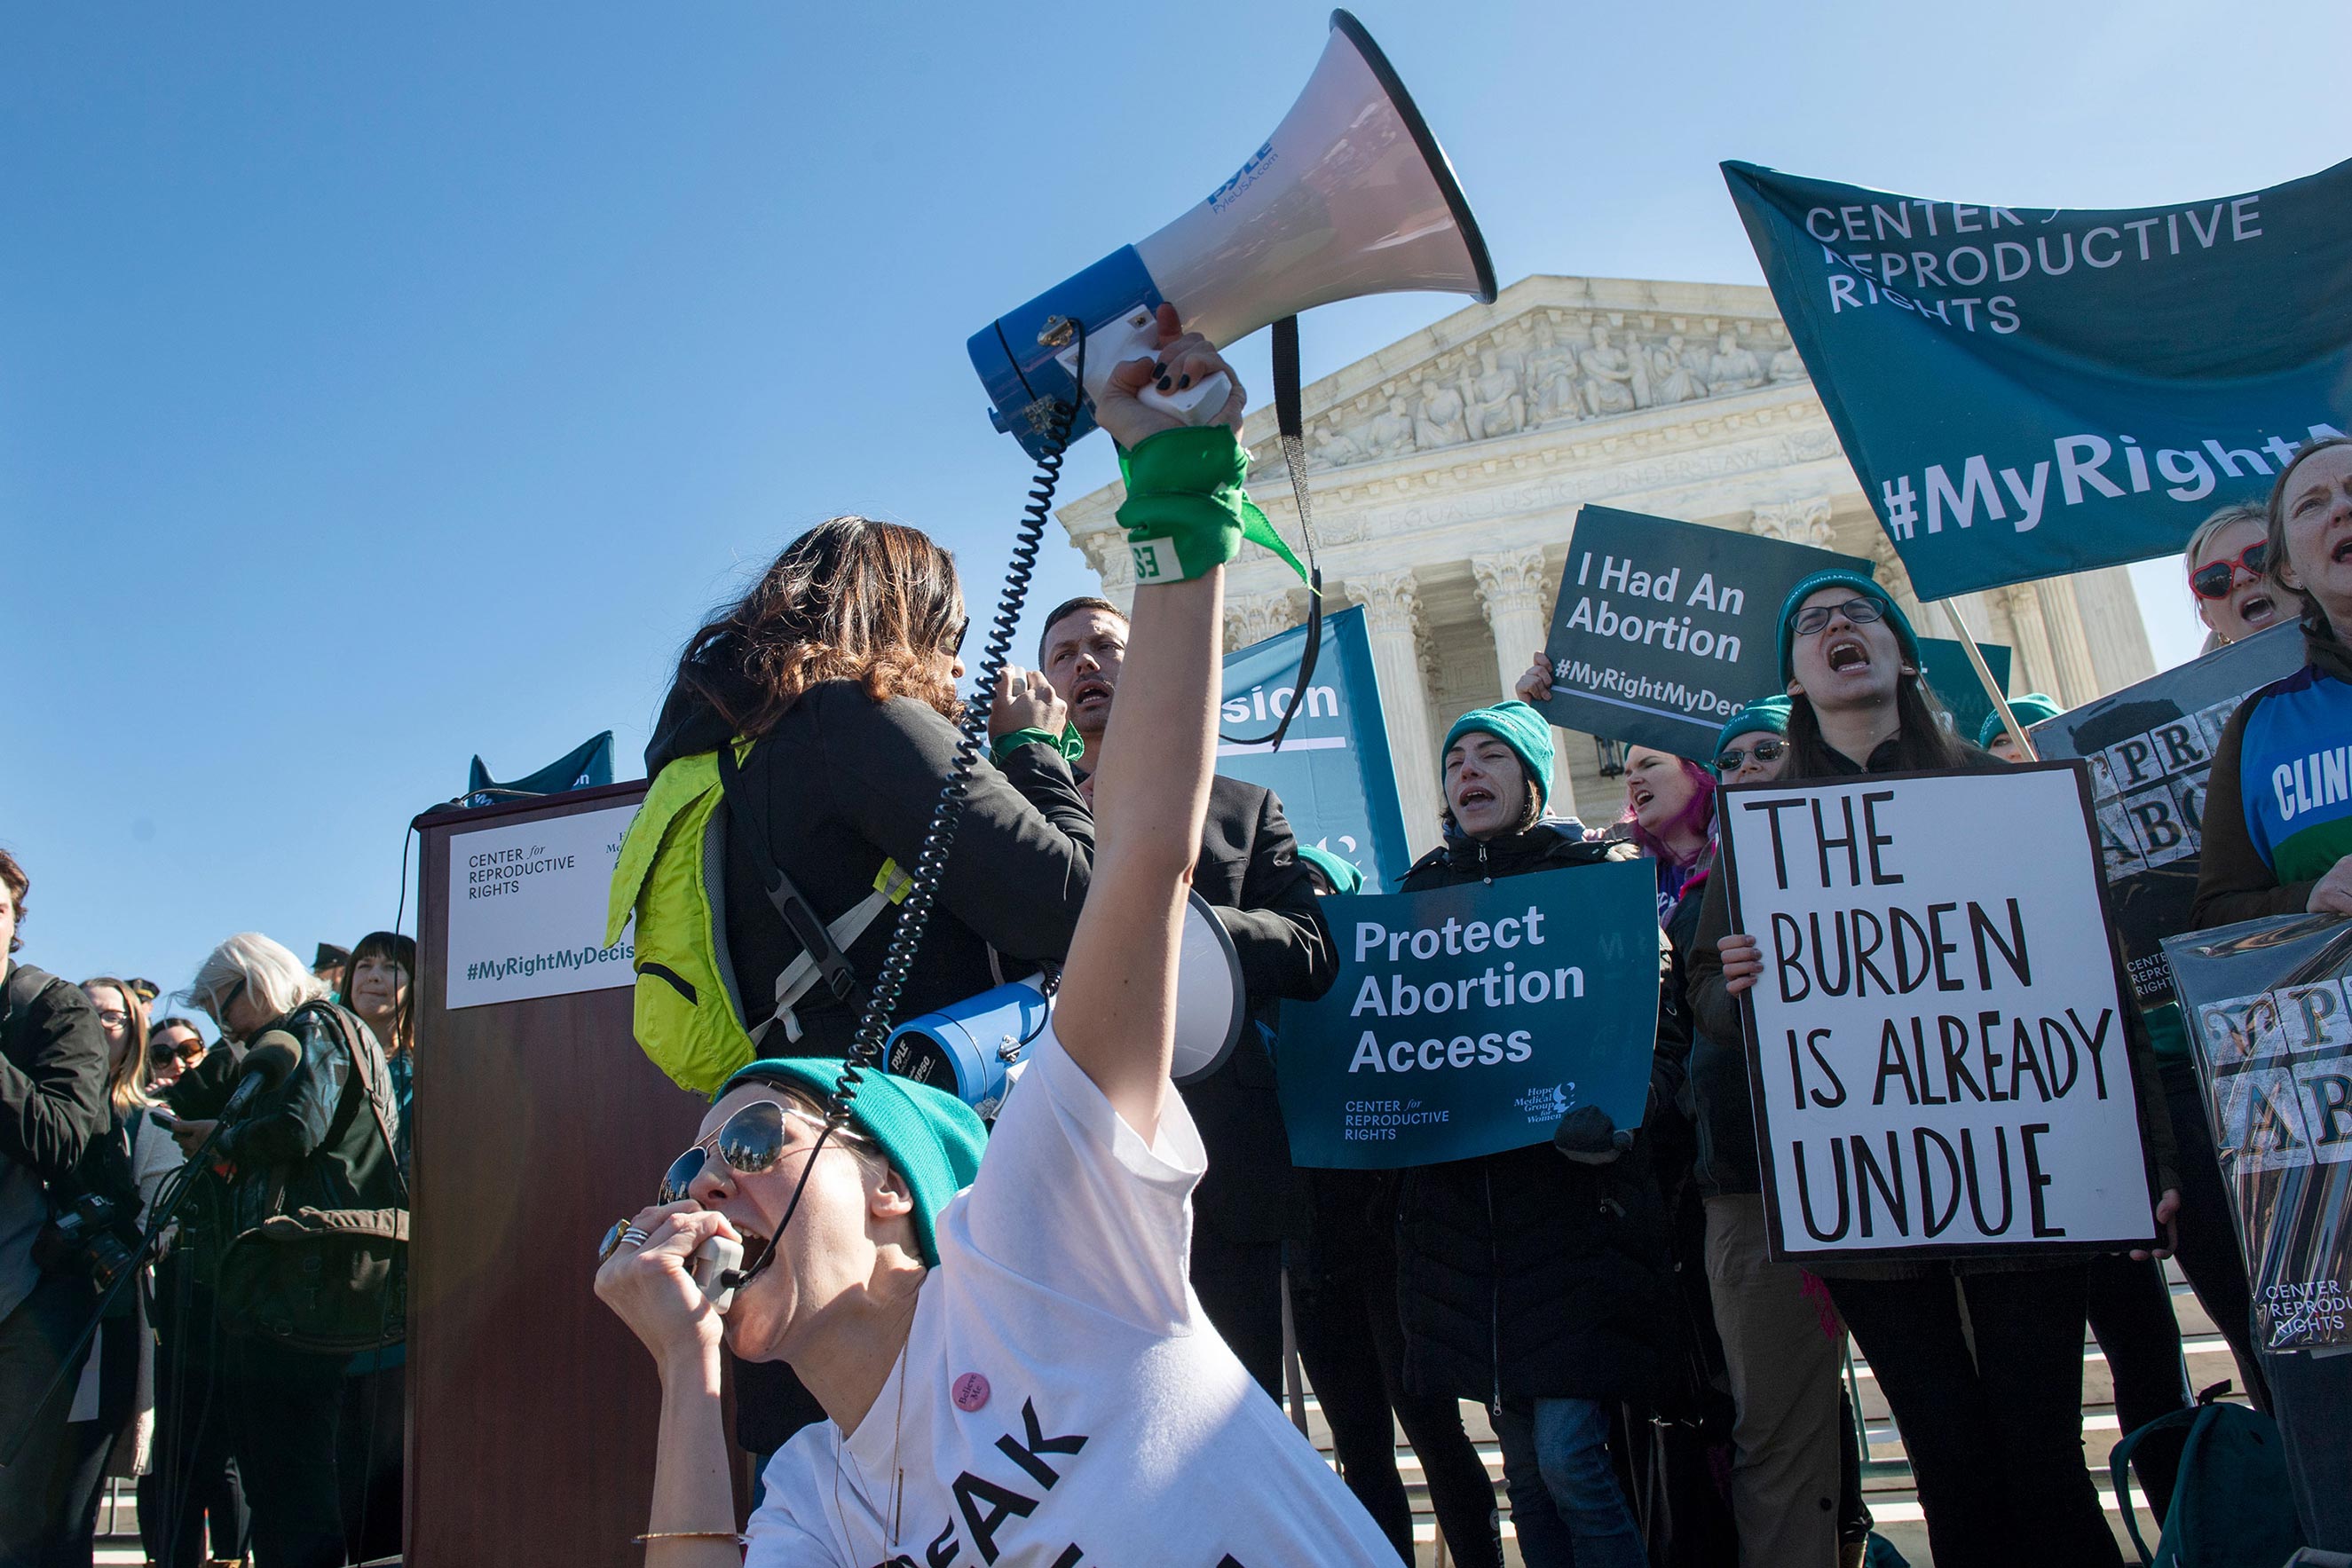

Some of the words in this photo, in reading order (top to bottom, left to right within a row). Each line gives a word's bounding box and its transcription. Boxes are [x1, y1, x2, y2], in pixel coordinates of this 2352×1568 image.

[1212, 154, 1278, 214] PyleUSA.com
[1827, 274, 2021, 335] RIGHTS
[1388, 496, 1473, 531] EQUAL
[1484, 477, 1590, 519] JUSTICE
[1602, 460, 1697, 493] UNDER
[1702, 449, 1761, 479] LAW
[1882, 422, 2348, 540] #MyRight
[1577, 551, 1592, 586] I
[1598, 555, 1680, 603] Had
[1685, 572, 1745, 615] An
[1566, 596, 1741, 663] Abortion
[1743, 791, 1905, 889] THE
[469, 848, 524, 868] CENTER
[526, 845, 546, 859] for
[469, 855, 575, 884] REPRODUCTIVE
[469, 880, 519, 900] RIGHTS
[1354, 905, 1545, 962] Protect
[1771, 898, 2032, 1003] BURDEN
[1350, 962, 1584, 1017] Abortion
[891, 1039, 909, 1070] PYLE
[1348, 1029, 1532, 1073] Access
[1786, 1028, 1847, 1110] IS
[1872, 1007, 2113, 1106] ALREADY
[1345, 1100, 1401, 1112] CENTER
[1403, 1099, 1422, 1111] for
[1513, 1093, 1552, 1107] Medical
[1524, 1102, 1554, 1112] Group
[1527, 1087, 1554, 1097] Hope
[1346, 1110, 1449, 1126] REPRODUCTIVE
[1527, 1114, 1562, 1123] Women
[1345, 1129, 1396, 1140] RIGHTS
[1792, 1123, 2066, 1242] UNDUE
[2266, 1280, 2340, 1299] CENTER
[2275, 1315, 2345, 1334] RIGHTS
[959, 1375, 976, 1404] Believe
[971, 1385, 983, 1400] Me
